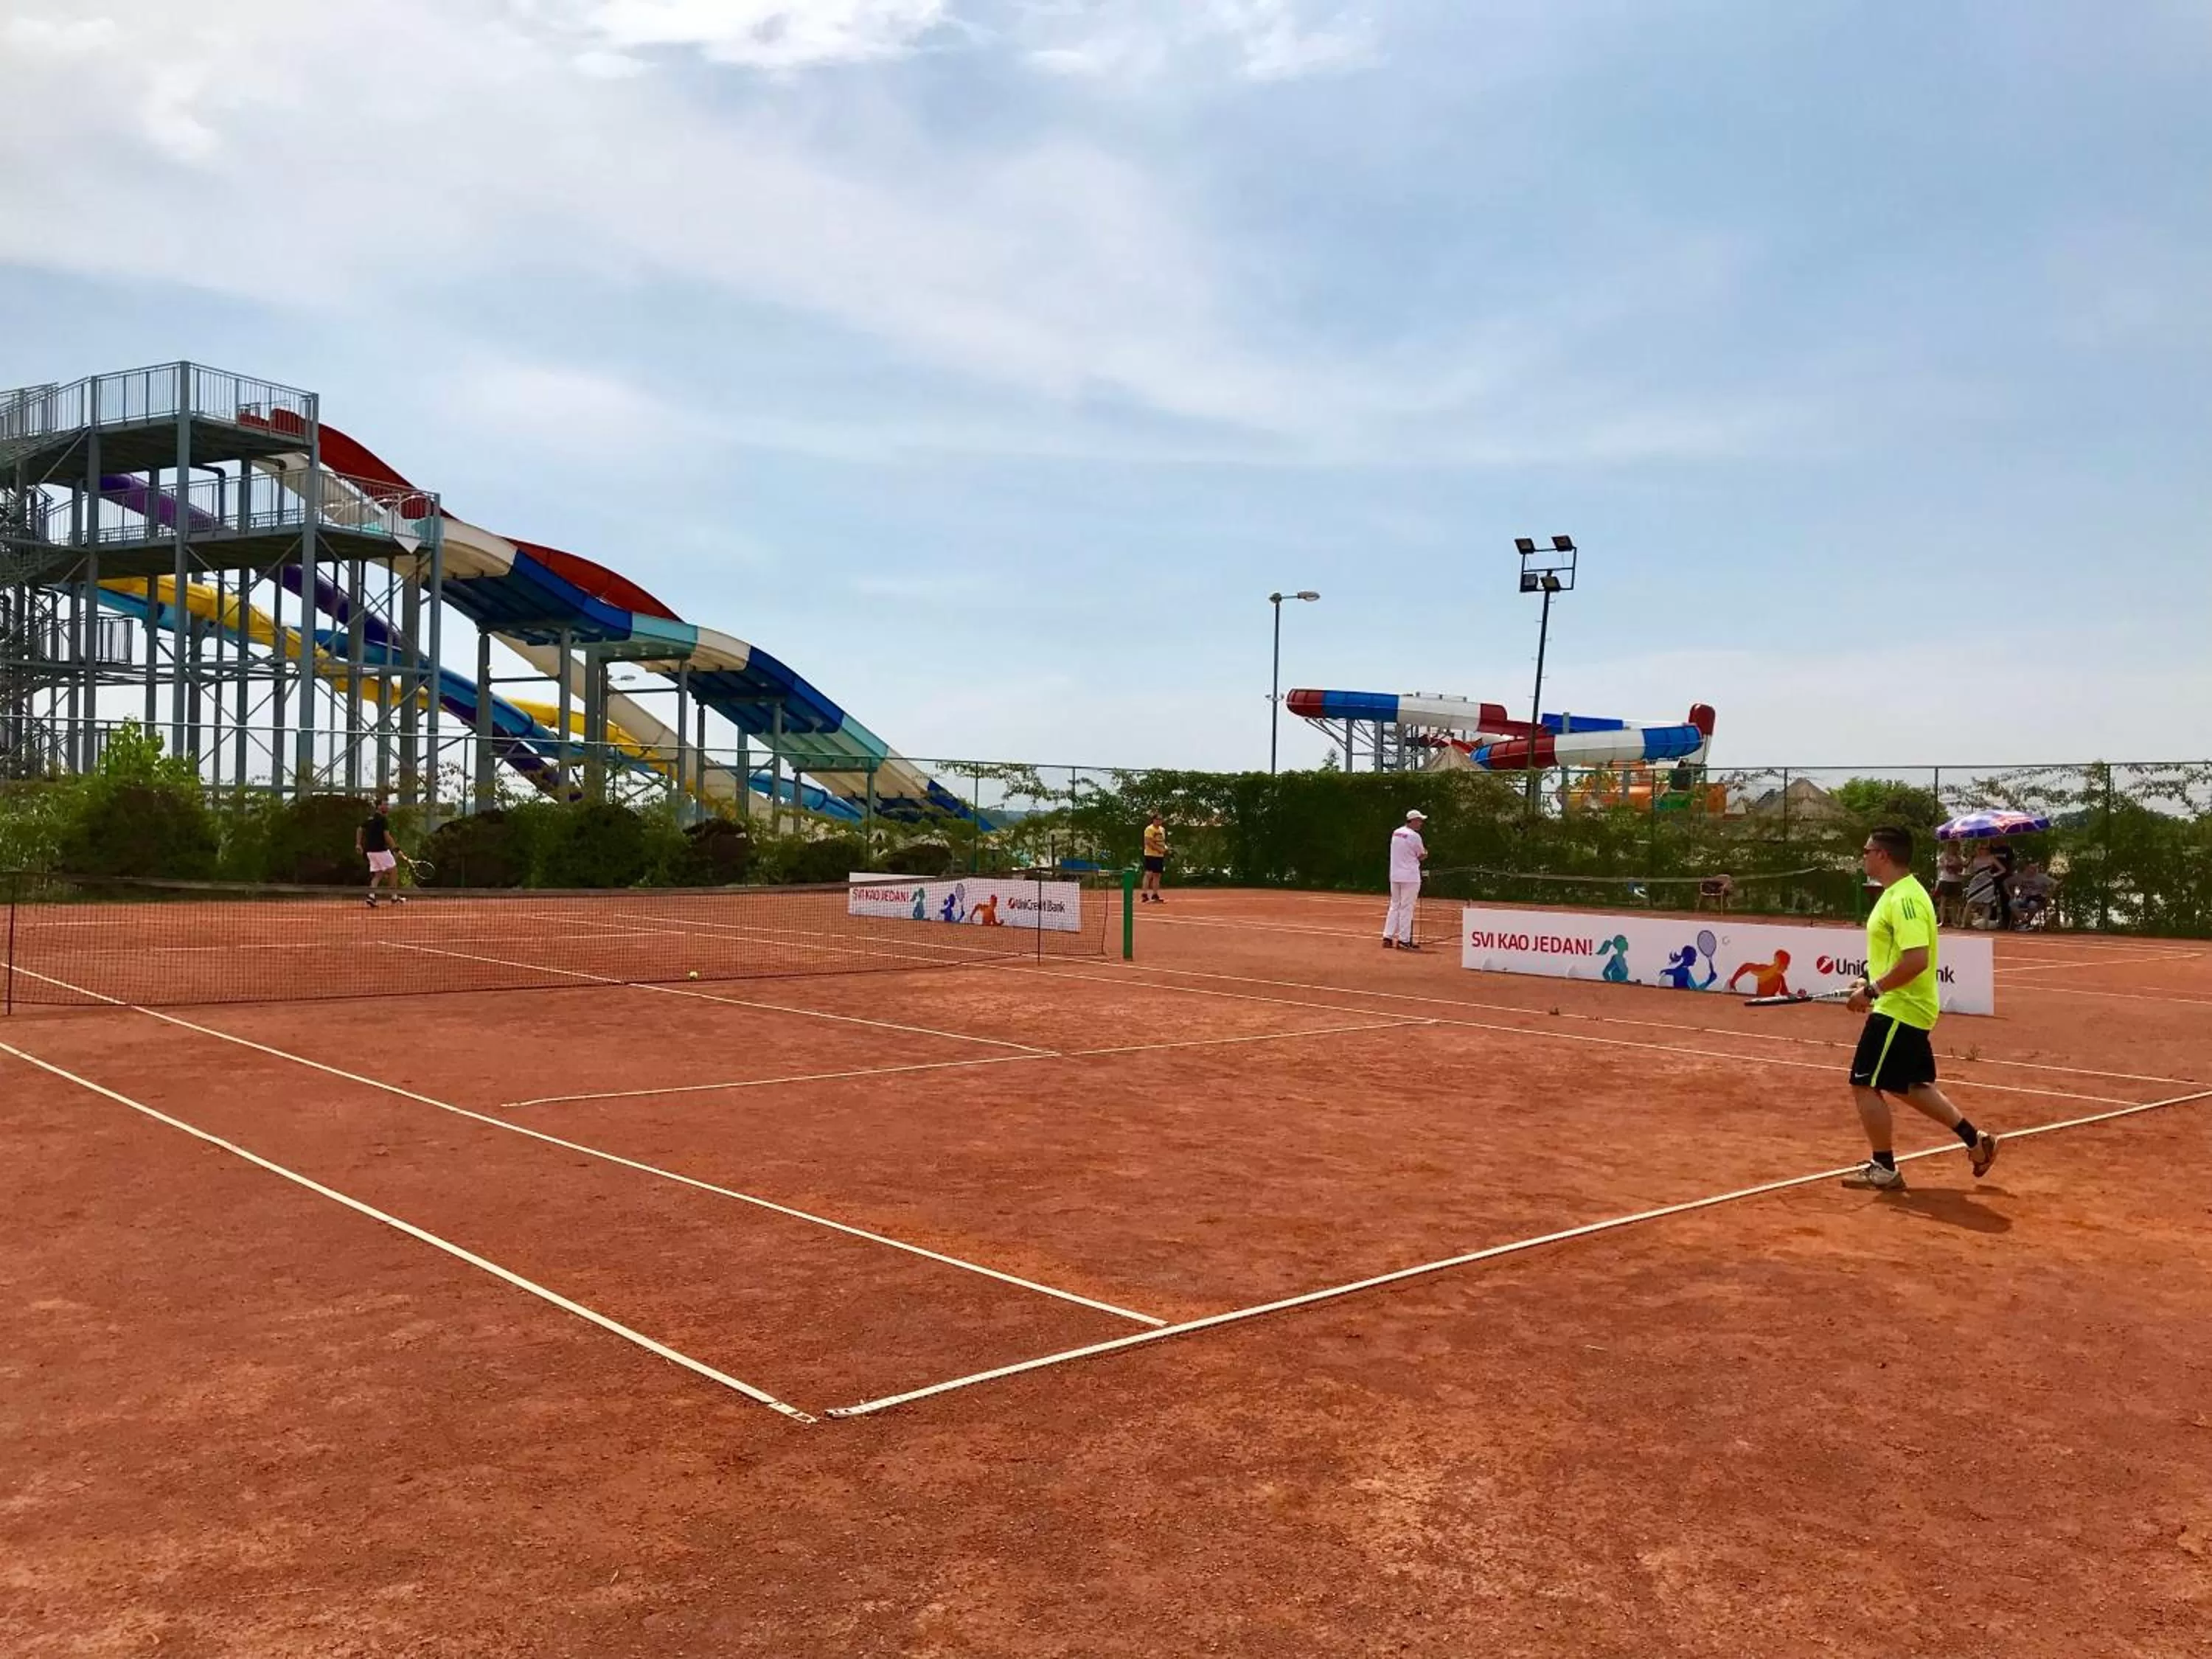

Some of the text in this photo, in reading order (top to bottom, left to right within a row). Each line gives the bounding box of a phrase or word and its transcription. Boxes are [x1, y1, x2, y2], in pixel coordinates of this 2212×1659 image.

[1016, 899, 1065, 914] UniCret Bank
[1472, 931, 1593, 956] SVI KAO JEDAN!
[1936, 966, 1955, 983] nk
